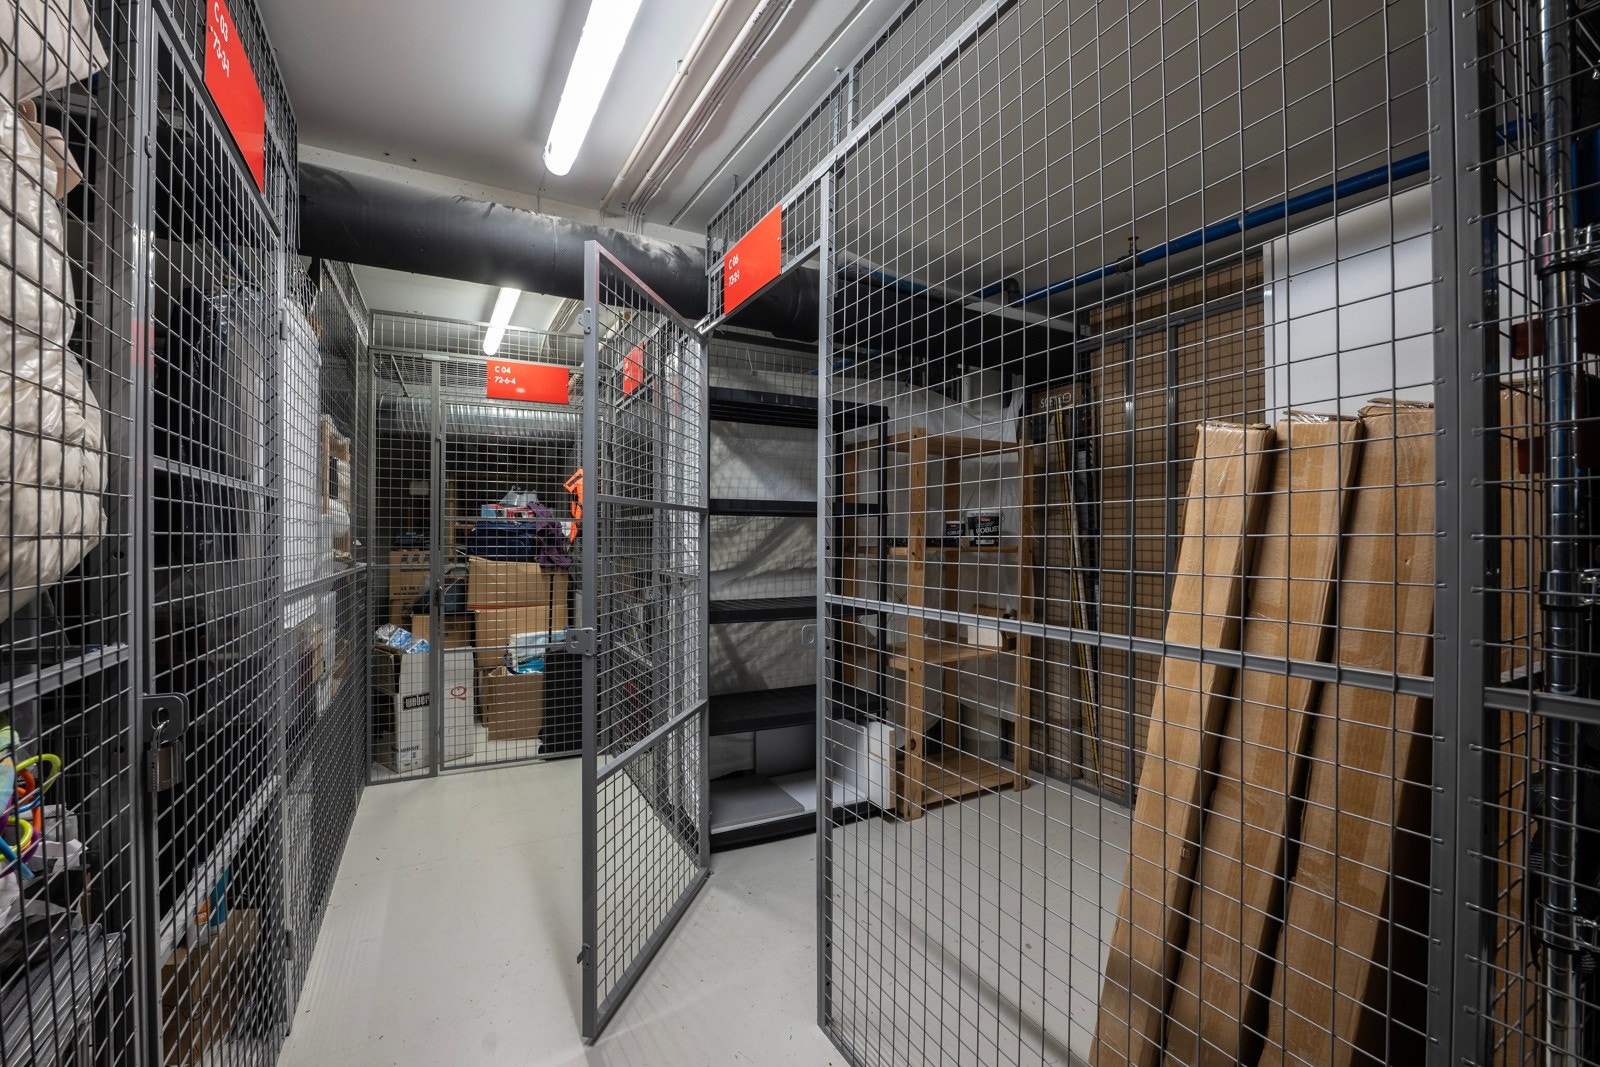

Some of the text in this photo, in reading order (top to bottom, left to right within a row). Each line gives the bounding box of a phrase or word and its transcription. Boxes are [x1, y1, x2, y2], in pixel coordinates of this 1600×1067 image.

[214, 1, 228, 43] C 03
[728, 258, 733, 270] C
[494, 365, 511, 374] C 04
[494, 376, 516, 385] 72-6-4
